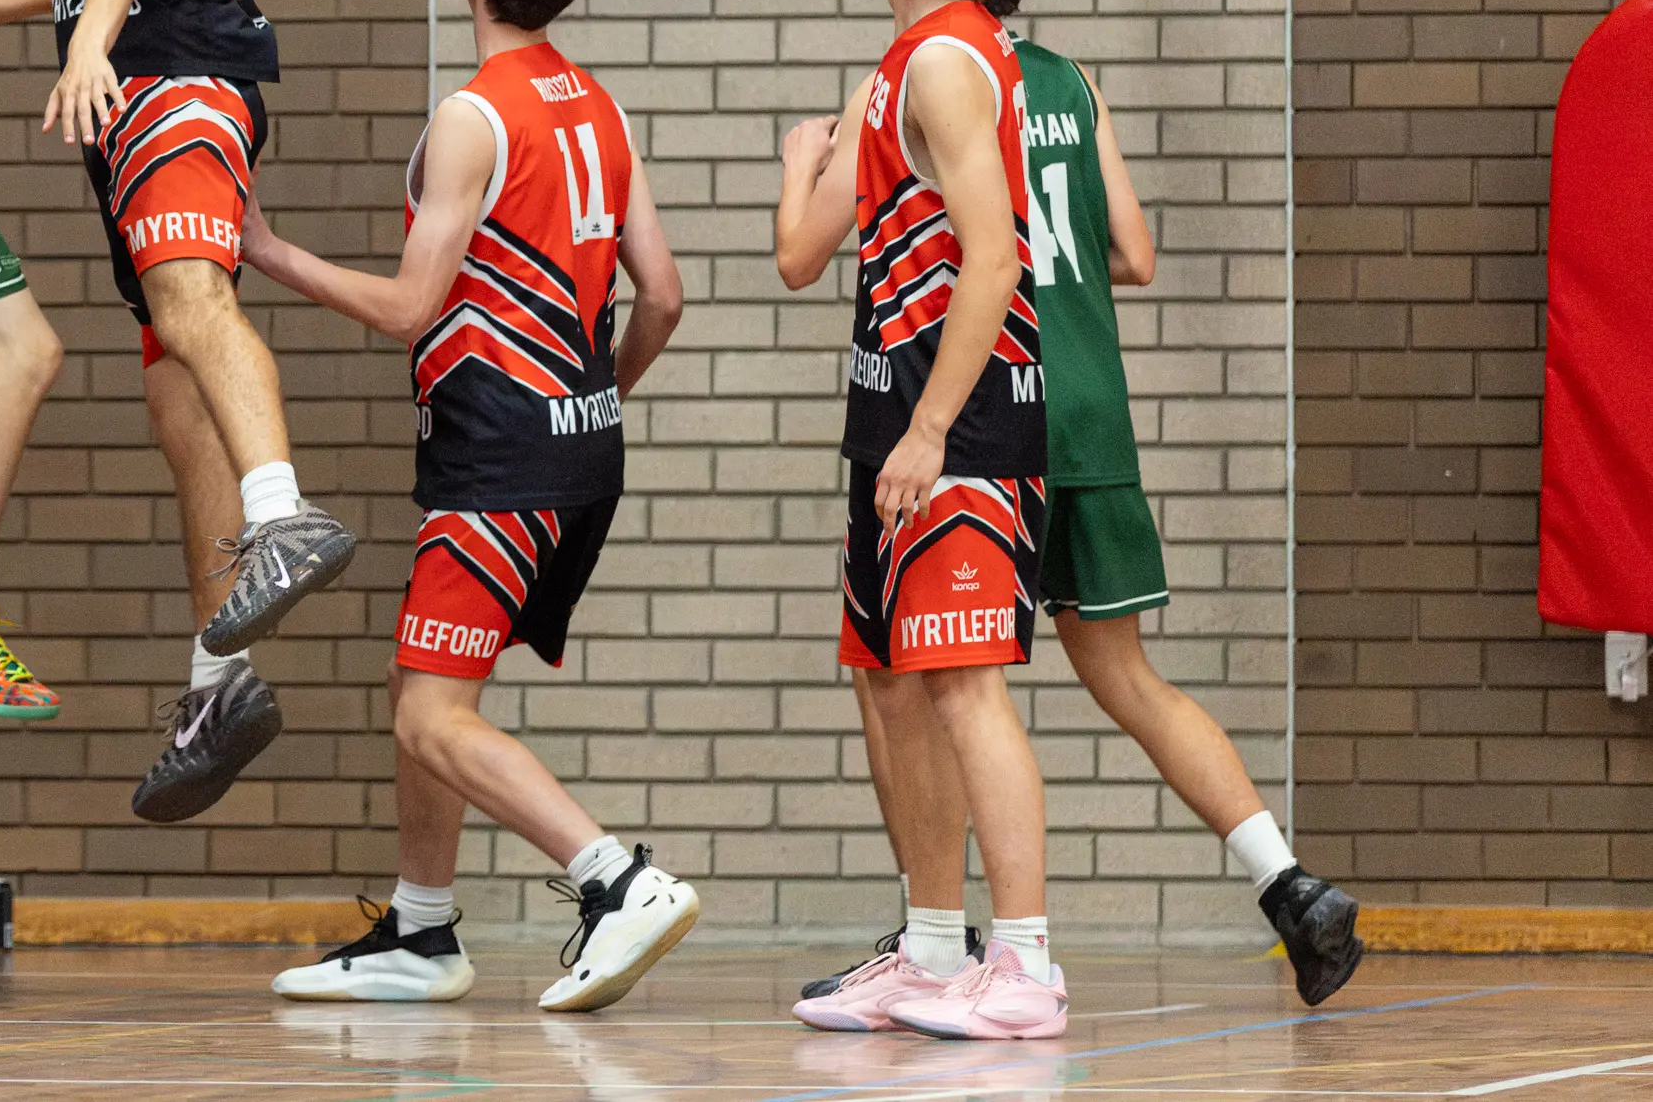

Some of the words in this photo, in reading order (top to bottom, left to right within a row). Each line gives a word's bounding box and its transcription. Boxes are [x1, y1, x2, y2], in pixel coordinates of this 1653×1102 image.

[554, 121, 615, 246] 11
[1027, 112, 1080, 148] HAN
[1028, 162, 1083, 287] 41
